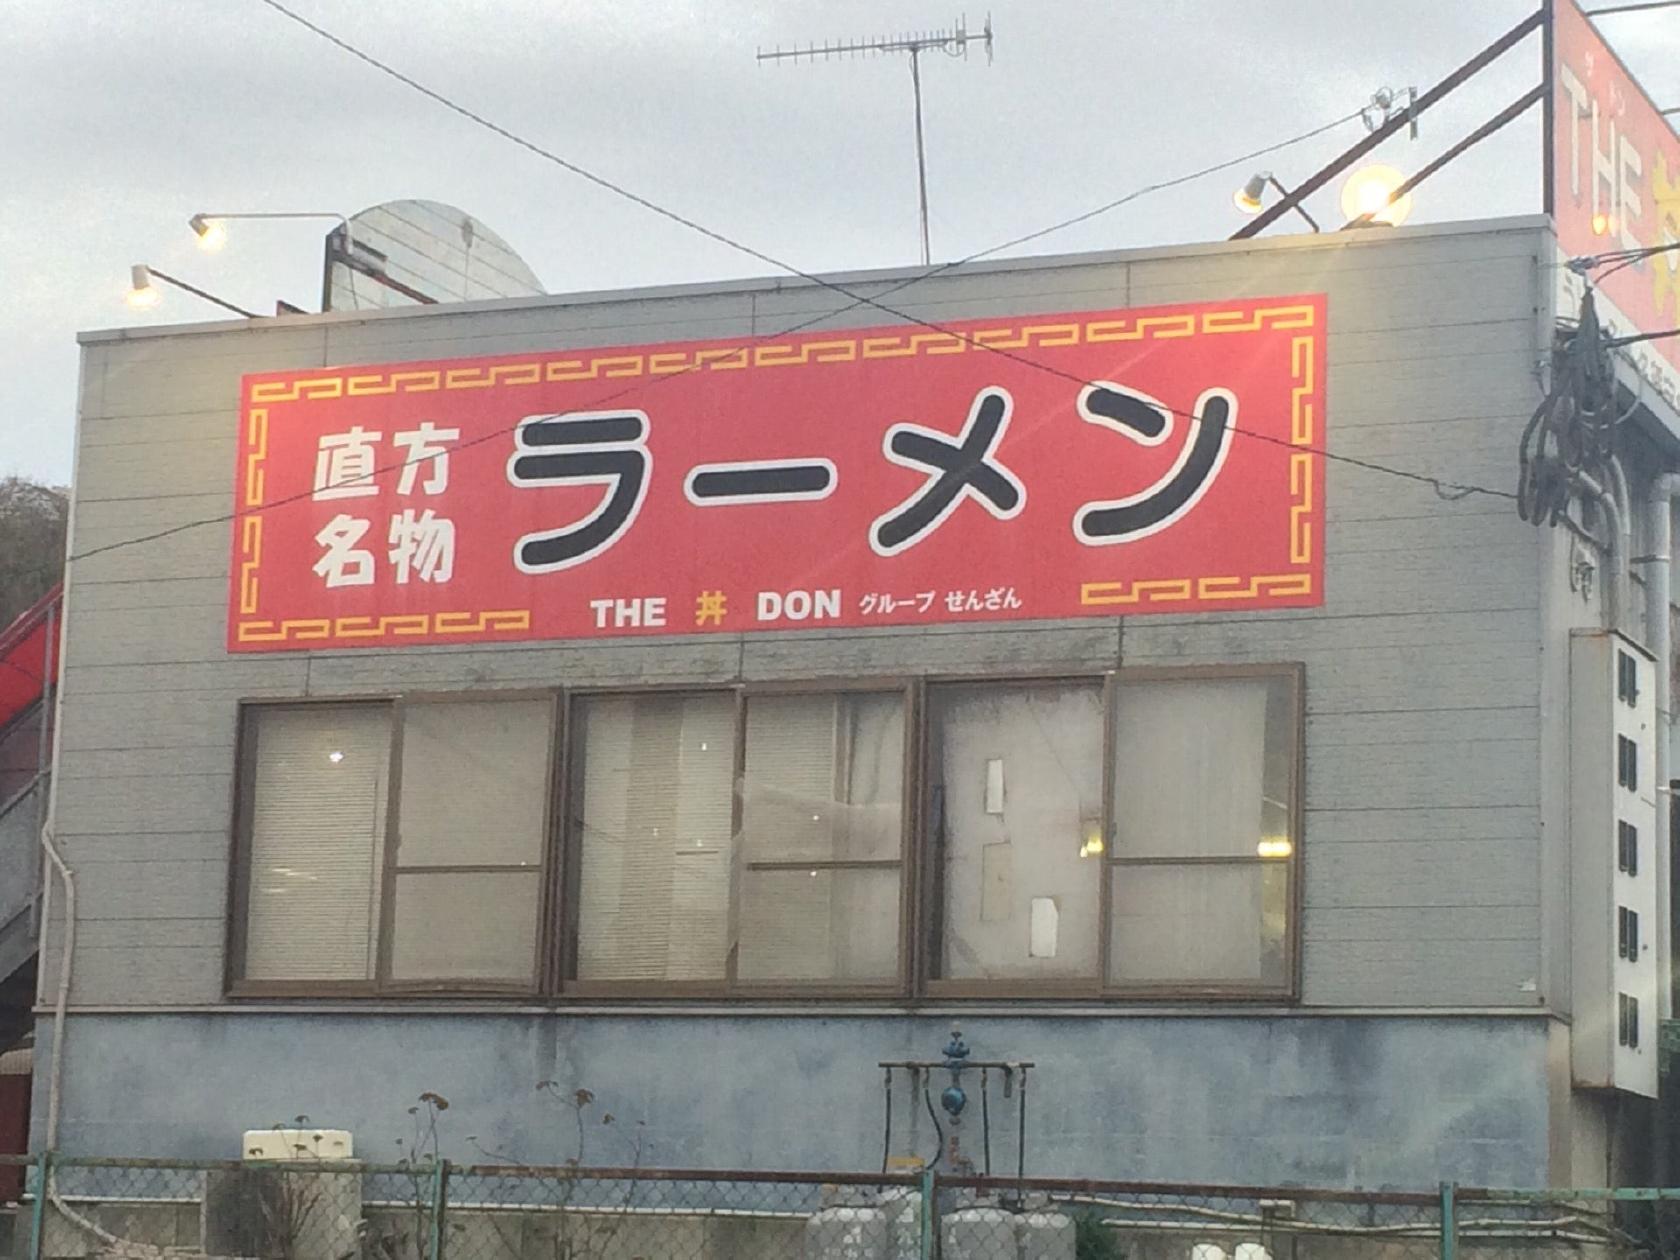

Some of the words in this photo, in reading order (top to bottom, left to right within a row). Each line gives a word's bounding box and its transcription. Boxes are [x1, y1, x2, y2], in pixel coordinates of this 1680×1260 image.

[1561, 63, 1644, 271] THE
[311, 421, 460, 502] 直方
[506, 380, 1238, 575] ラーメン
[311, 508, 456, 589] 名物
[590, 597, 667, 628] THE
[695, 590, 727, 626] 丼
[757, 589, 841, 621] DON
[859, 590, 936, 615] グループ
[944, 587, 1022, 612] せんざん
